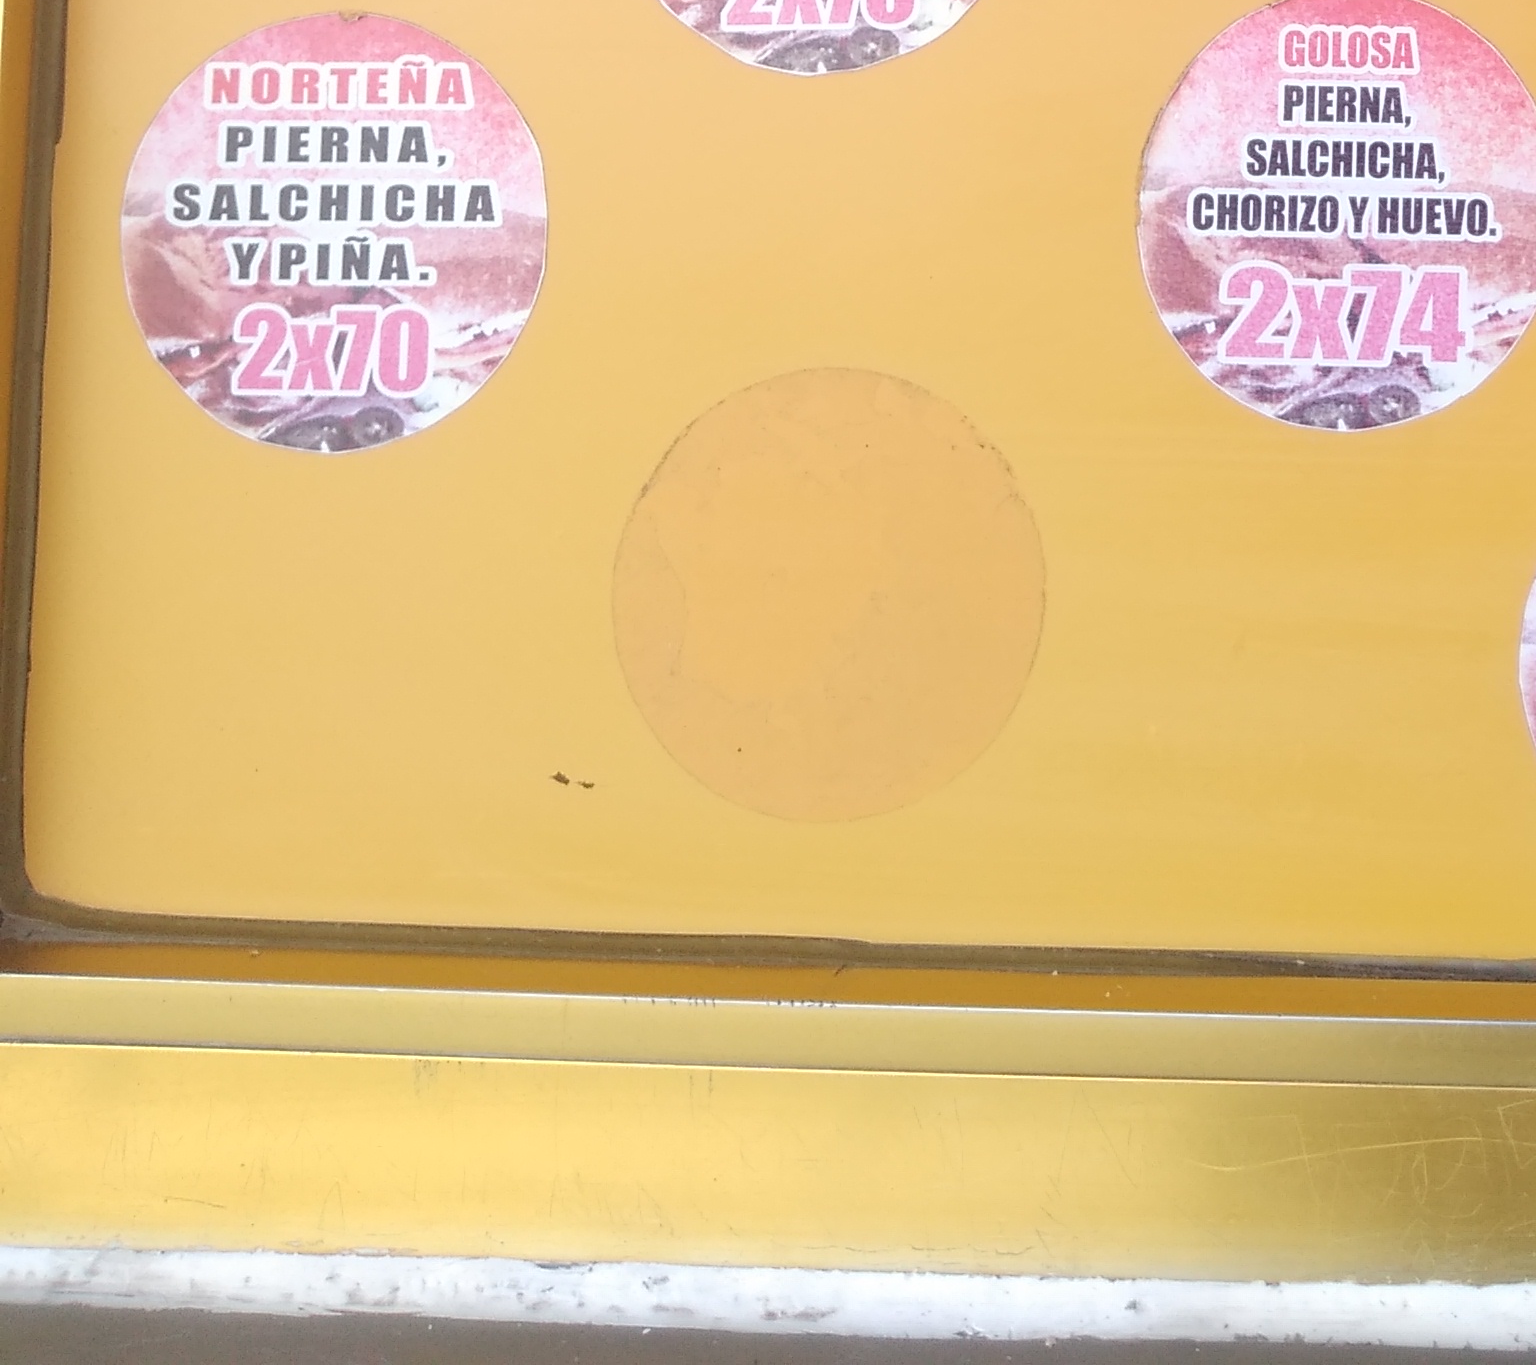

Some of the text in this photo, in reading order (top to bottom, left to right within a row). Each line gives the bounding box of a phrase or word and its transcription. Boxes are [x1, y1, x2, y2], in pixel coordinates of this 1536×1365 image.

[1282, 28, 1416, 71] GOLOSA
[209, 58, 468, 107] NORTEÑA
[1281, 83, 1415, 129] PIERNA,
[223, 124, 451, 169] PIERNA,
[1244, 137, 1448, 186] SALCHICHA,
[171, 181, 497, 224] SALCHICHA
[1191, 191, 1498, 238] CHORIZO Y HUEVO.
[228, 234, 433, 283] Y PIÑA.
[1224, 265, 1467, 364] 2x74
[235, 307, 431, 394] 2x70
